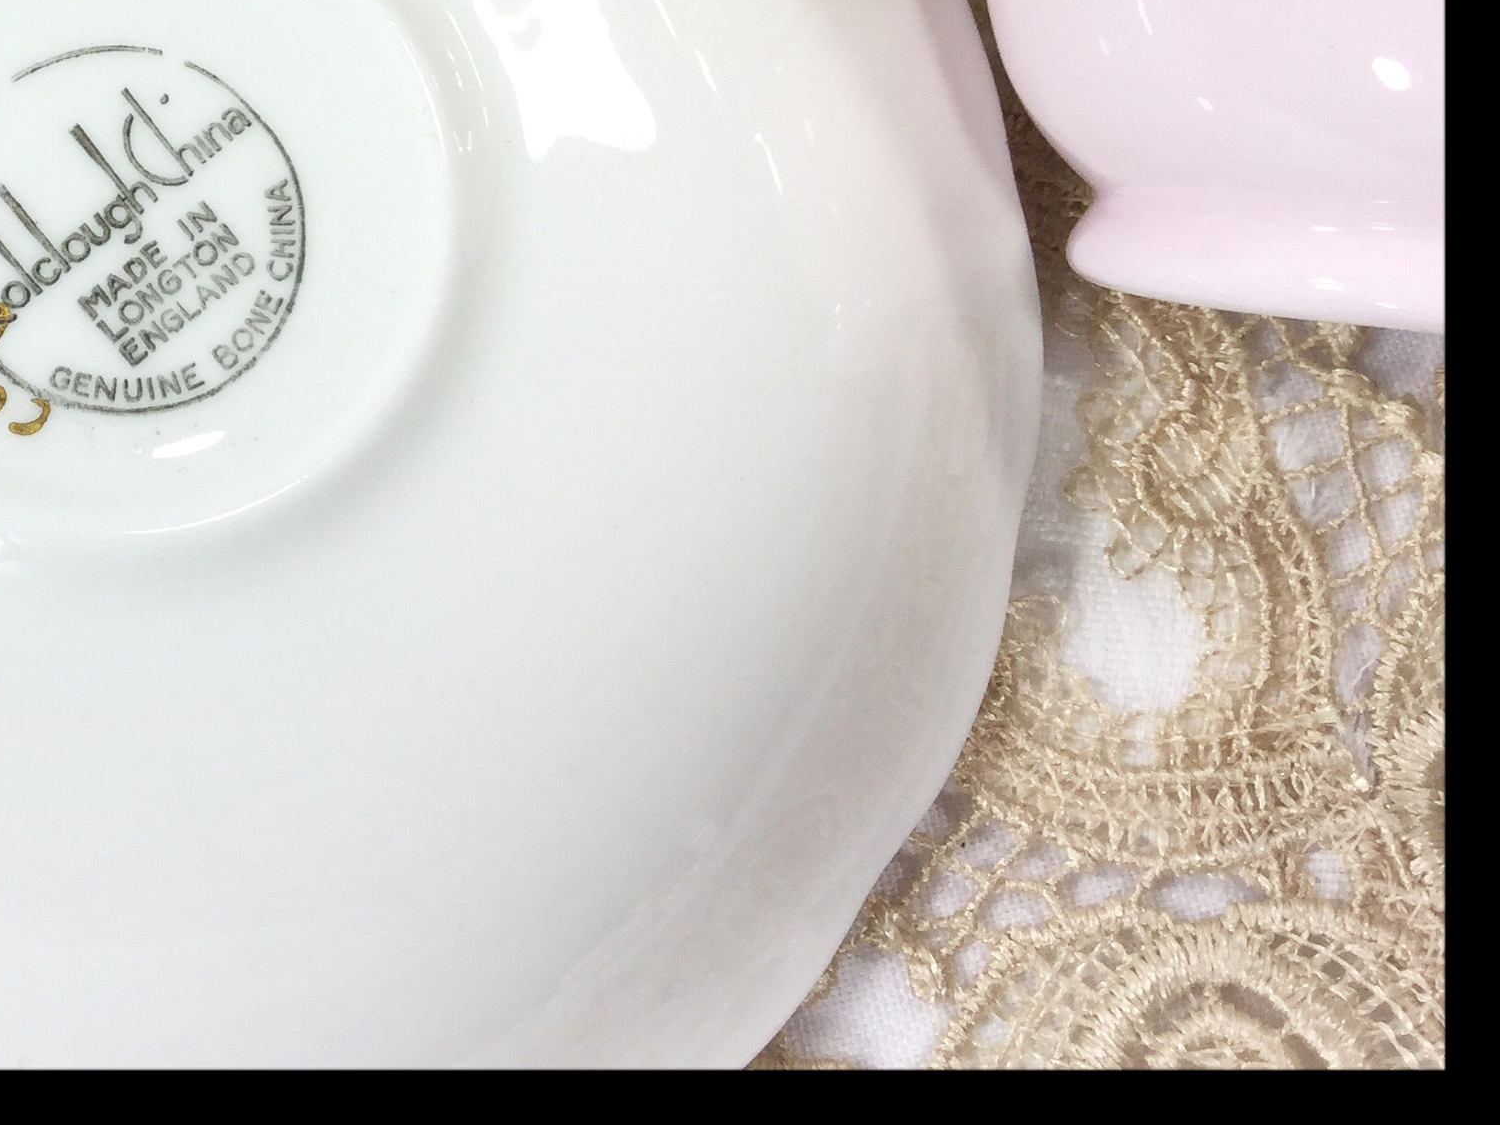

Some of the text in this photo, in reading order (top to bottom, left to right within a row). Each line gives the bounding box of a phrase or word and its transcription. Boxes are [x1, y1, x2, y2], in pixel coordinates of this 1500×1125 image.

[122, 87, 252, 186] China
[49, 178, 293, 403] GENUINE BONE CHINA
[77, 200, 219, 320] MADE IN
[96, 222, 240, 344] LONGTON
[118, 251, 255, 367] ENGLAND
